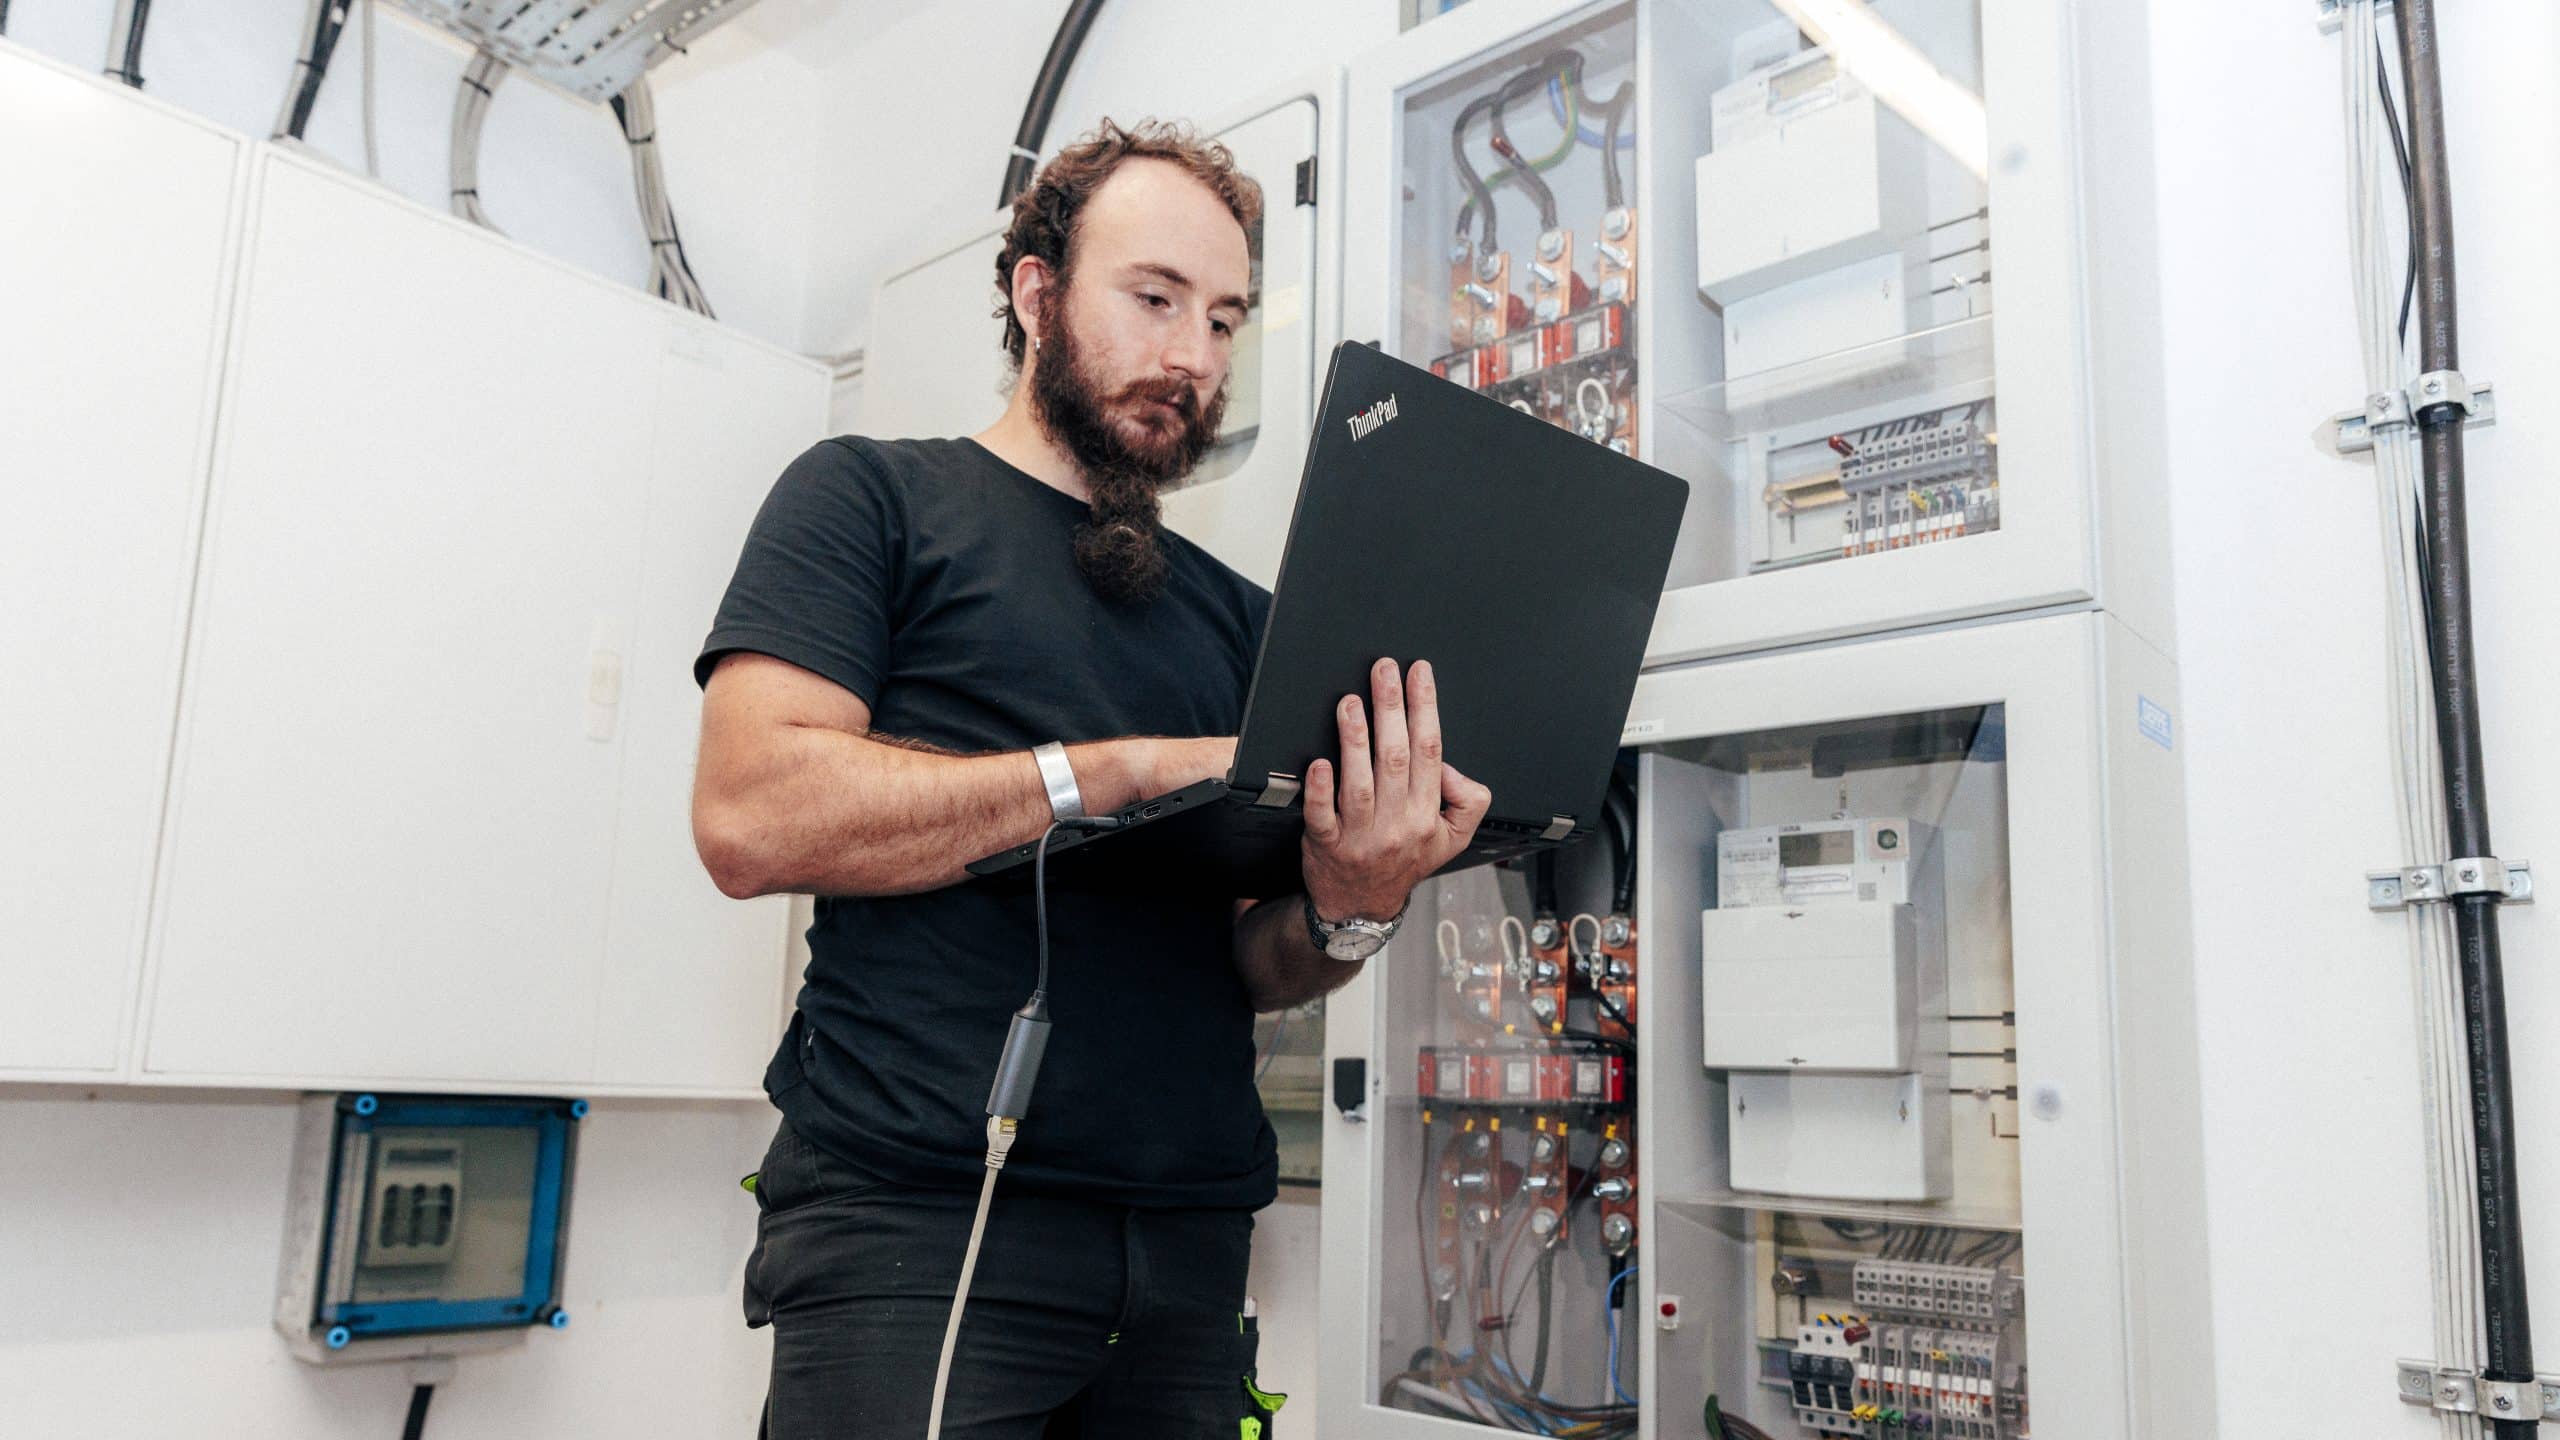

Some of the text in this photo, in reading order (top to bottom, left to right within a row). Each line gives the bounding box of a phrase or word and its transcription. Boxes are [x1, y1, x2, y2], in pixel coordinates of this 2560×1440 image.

[2432, 276, 2444, 303] 2021
[1346, 392, 1399, 443] ThinkPad
[2467, 936, 2480, 963] 2021
